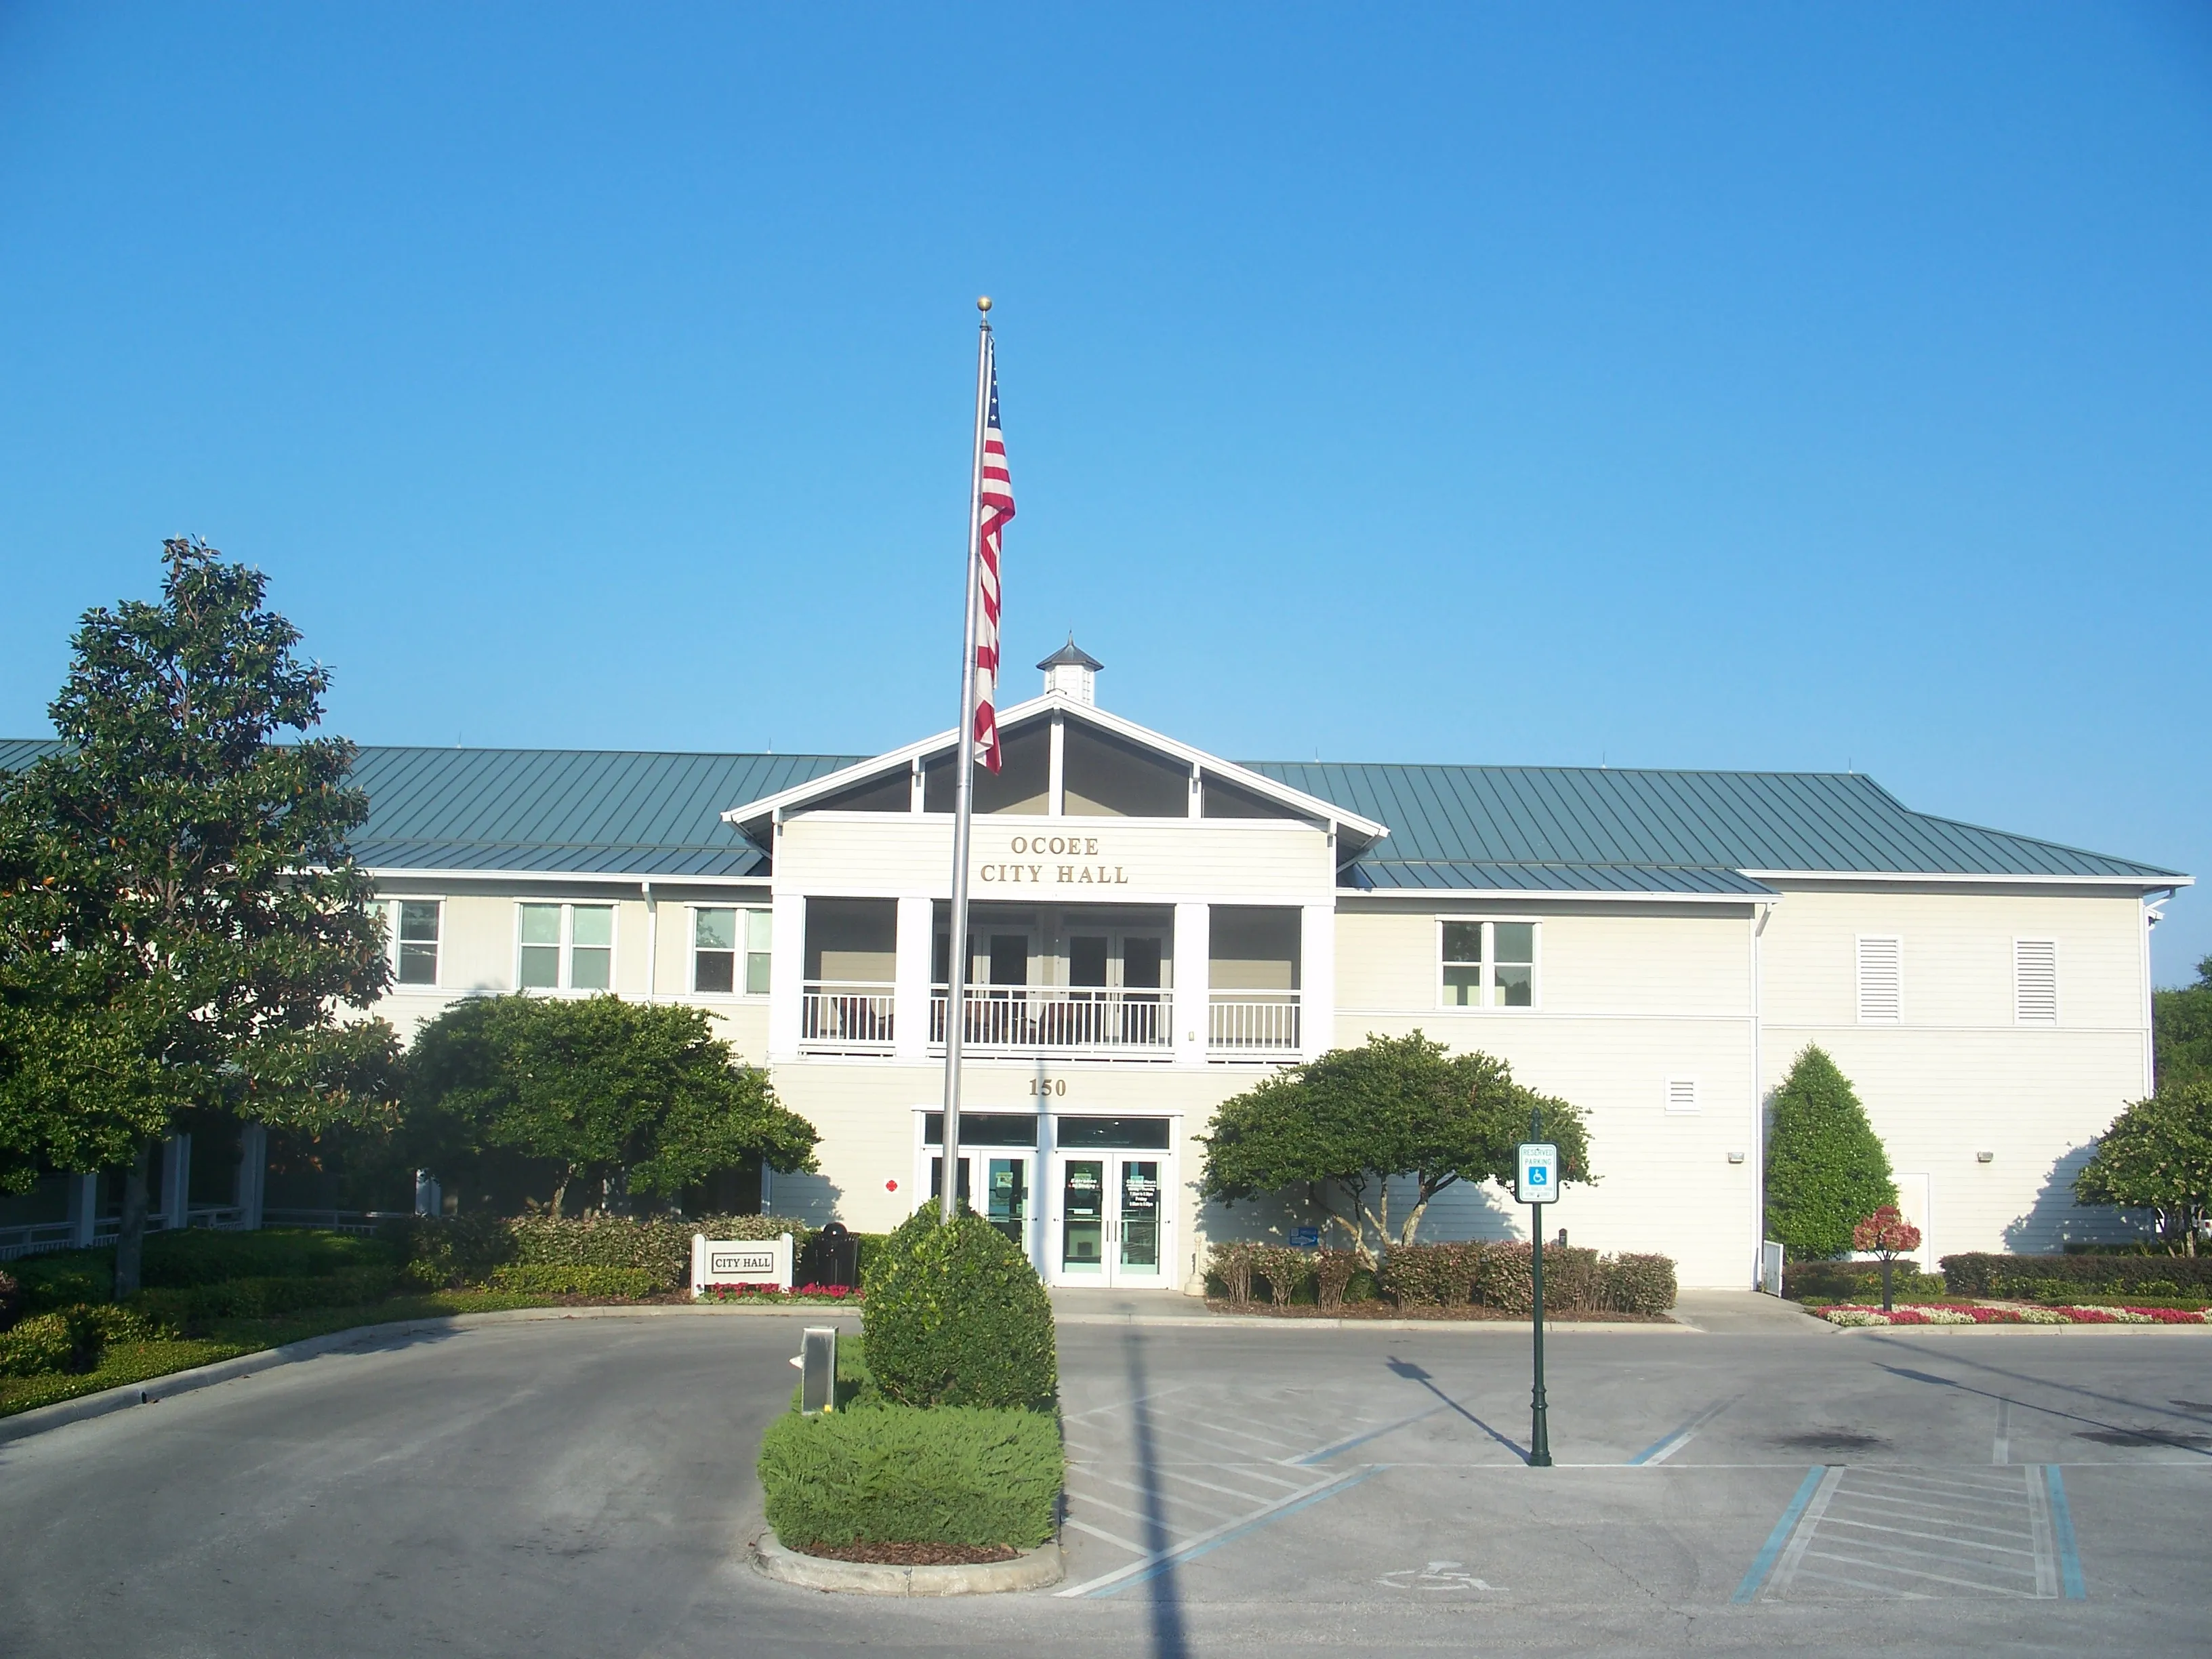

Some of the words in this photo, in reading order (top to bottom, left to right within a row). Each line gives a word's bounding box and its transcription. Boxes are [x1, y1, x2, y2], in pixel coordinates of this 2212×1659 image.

[1011, 837, 1099, 855] OCOEE
[981, 865, 1042, 882] CITY
[1057, 866, 1128, 884] HALL
[1029, 1078, 1066, 1097] 150
[715, 1258, 740, 1267] CITY
[743, 1258, 771, 1267] HALL
